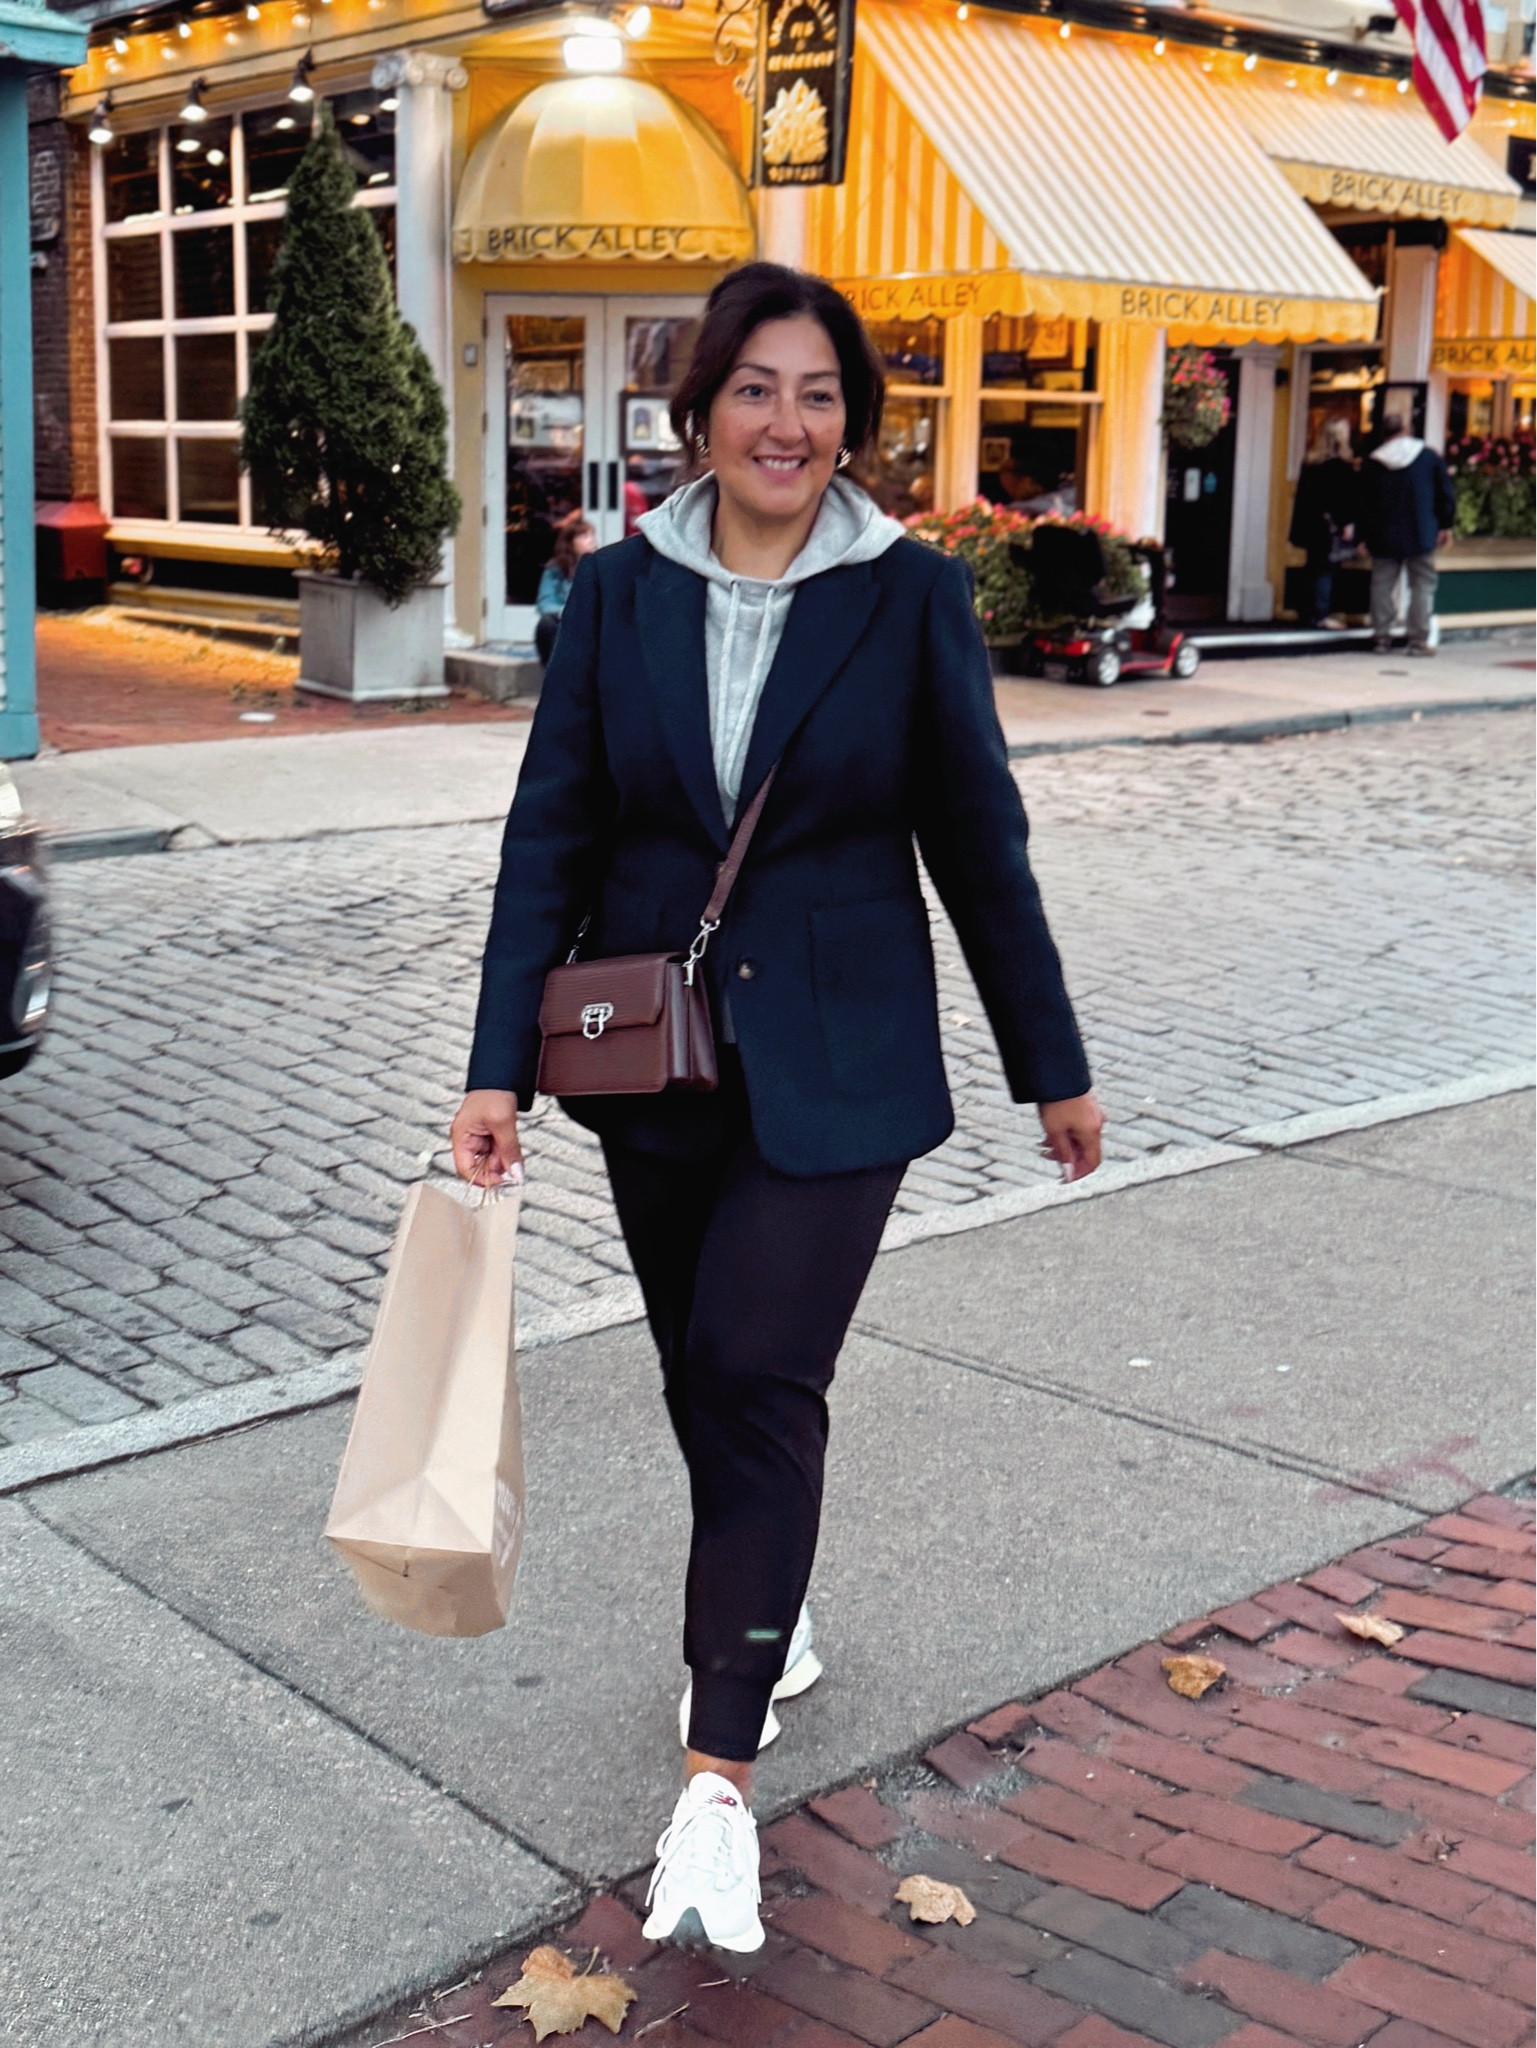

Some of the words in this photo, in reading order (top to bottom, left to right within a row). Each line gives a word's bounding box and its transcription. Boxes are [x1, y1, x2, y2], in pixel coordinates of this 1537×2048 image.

[1331, 172, 1394, 202] BRICK
[1400, 182, 1463, 214] ALLEY
[487, 226, 574, 252] BRICK
[587, 225, 686, 250] ALLEY
[844, 285, 900, 312] RICK
[906, 282, 983, 309] ALLEY
[1120, 287, 1200, 320] BRICK
[1206, 296, 1286, 325] ALLEY
[1432, 344, 1497, 365] BRICK
